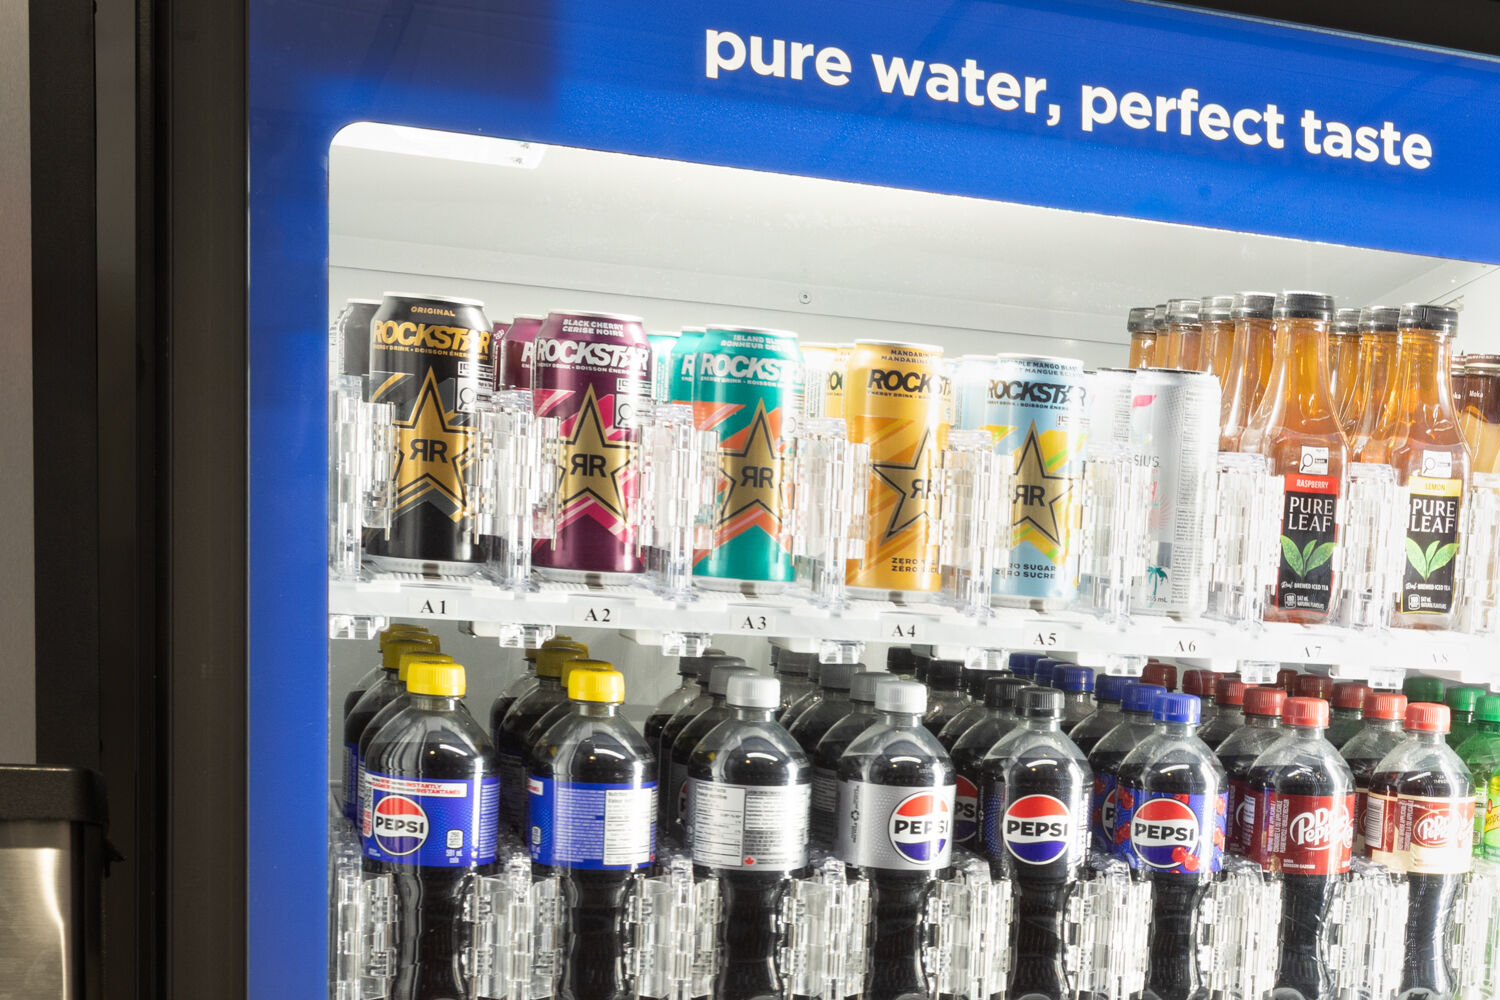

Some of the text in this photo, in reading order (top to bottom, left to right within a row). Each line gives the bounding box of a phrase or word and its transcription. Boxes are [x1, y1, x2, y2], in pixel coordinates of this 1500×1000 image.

[705, 28, 1433, 169] pure water, perfect taste
[411, 306, 455, 317] ORIGINAL
[562, 319, 624, 330] BLACK CHERRY
[562, 326, 624, 337] CERISE NOIRE
[374, 320, 491, 354] ROCKSTAR
[536, 338, 649, 371] ROCKSTAR
[1025, 368, 1058, 376] MANGUE
[1032, 361, 1060, 370] MANGO
[1296, 479, 1329, 489] RASPBERRY
[1425, 483, 1446, 491] LEMON
[1289, 496, 1334, 516] PURE
[1412, 499, 1456, 517] PURE
[1288, 513, 1332, 532] LEAF
[1410, 515, 1455, 534] LEAF
[1023, 563, 1057, 572] SUGAR
[1023, 571, 1055, 580] SUCRE
[375, 816, 424, 834] PEPSI
[893, 819, 949, 836] PEPSI
[1007, 820, 1068, 837] PEPSI
[1134, 822, 1194, 842] PEPSI
